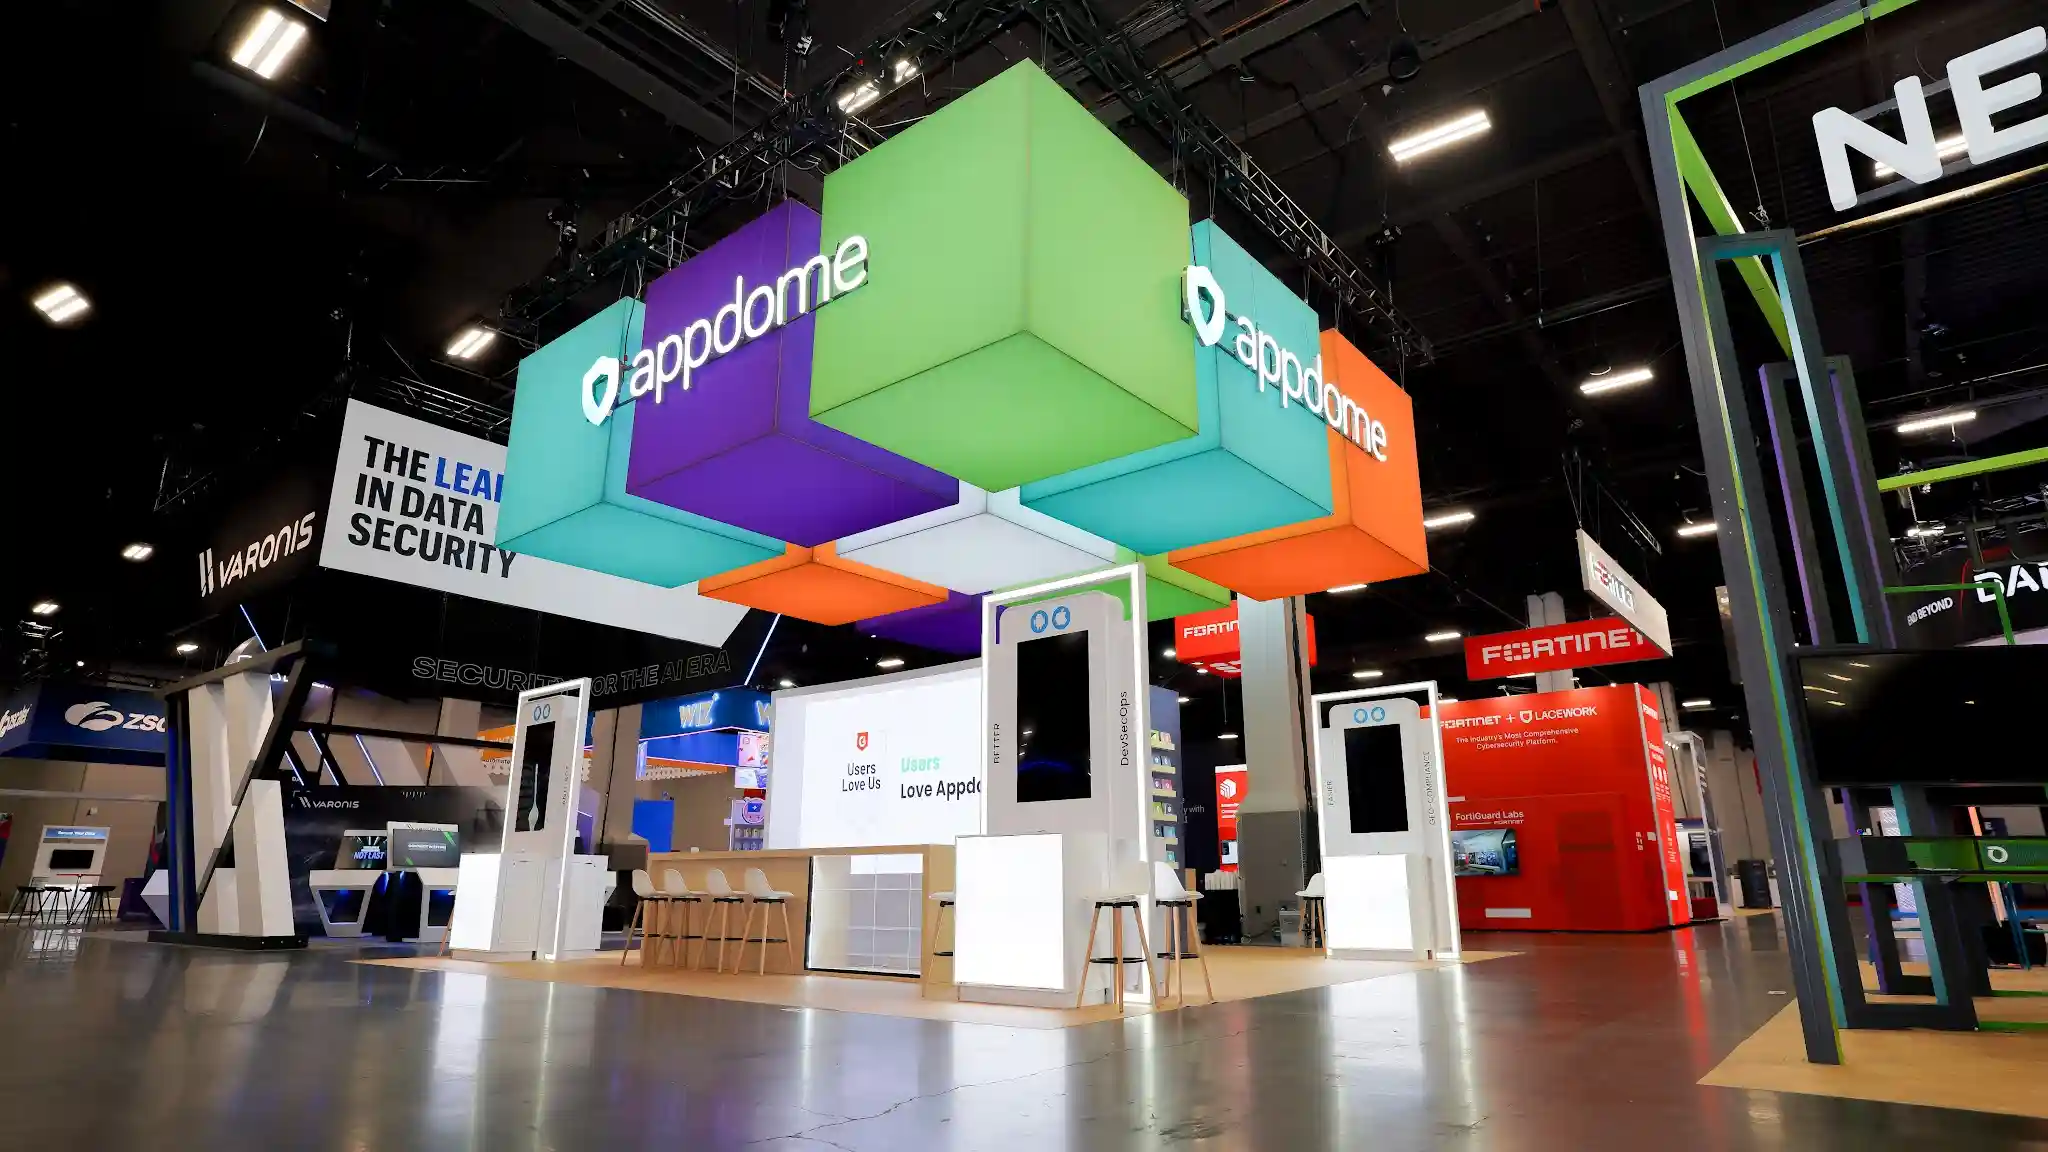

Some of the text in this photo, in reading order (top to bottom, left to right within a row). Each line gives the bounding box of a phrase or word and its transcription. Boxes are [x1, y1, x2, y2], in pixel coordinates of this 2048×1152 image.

[629, 235, 868, 404] appdome
[1236, 316, 1387, 462] appdome
[363, 434, 431, 483] THE
[354, 472, 486, 536] IN DATA
[218, 511, 316, 589] VARONIS
[348, 511, 518, 579] SECURITY
[1916, 596, 1954, 622] BEYOND
[1482, 627, 1646, 665] FORTINET
[620, 664, 660, 692] THE
[660, 659, 683, 684] AI
[685, 650, 731, 679] ERA
[1119, 691, 1131, 766] DevSecOps
[1440, 715, 1502, 729] FORTINET
[1535, 706, 1598, 721] LACEWORK
[1456, 736, 1469, 744] The
[1504, 731, 1522, 739] Most
[1523, 727, 1579, 739] Comprehensive
[1476, 737, 1558, 751] Cybersecurity Platform.
[847, 763, 876, 776] Users
[901, 757, 940, 773] Users
[842, 776, 881, 791] Love Us
[901, 783, 932, 799] Love
[1423, 751, 1436, 826] GEO-COMPLIANCE
[312, 801, 360, 809] VARONIS
[1455, 810, 1524, 821] FortiGuard Labs
